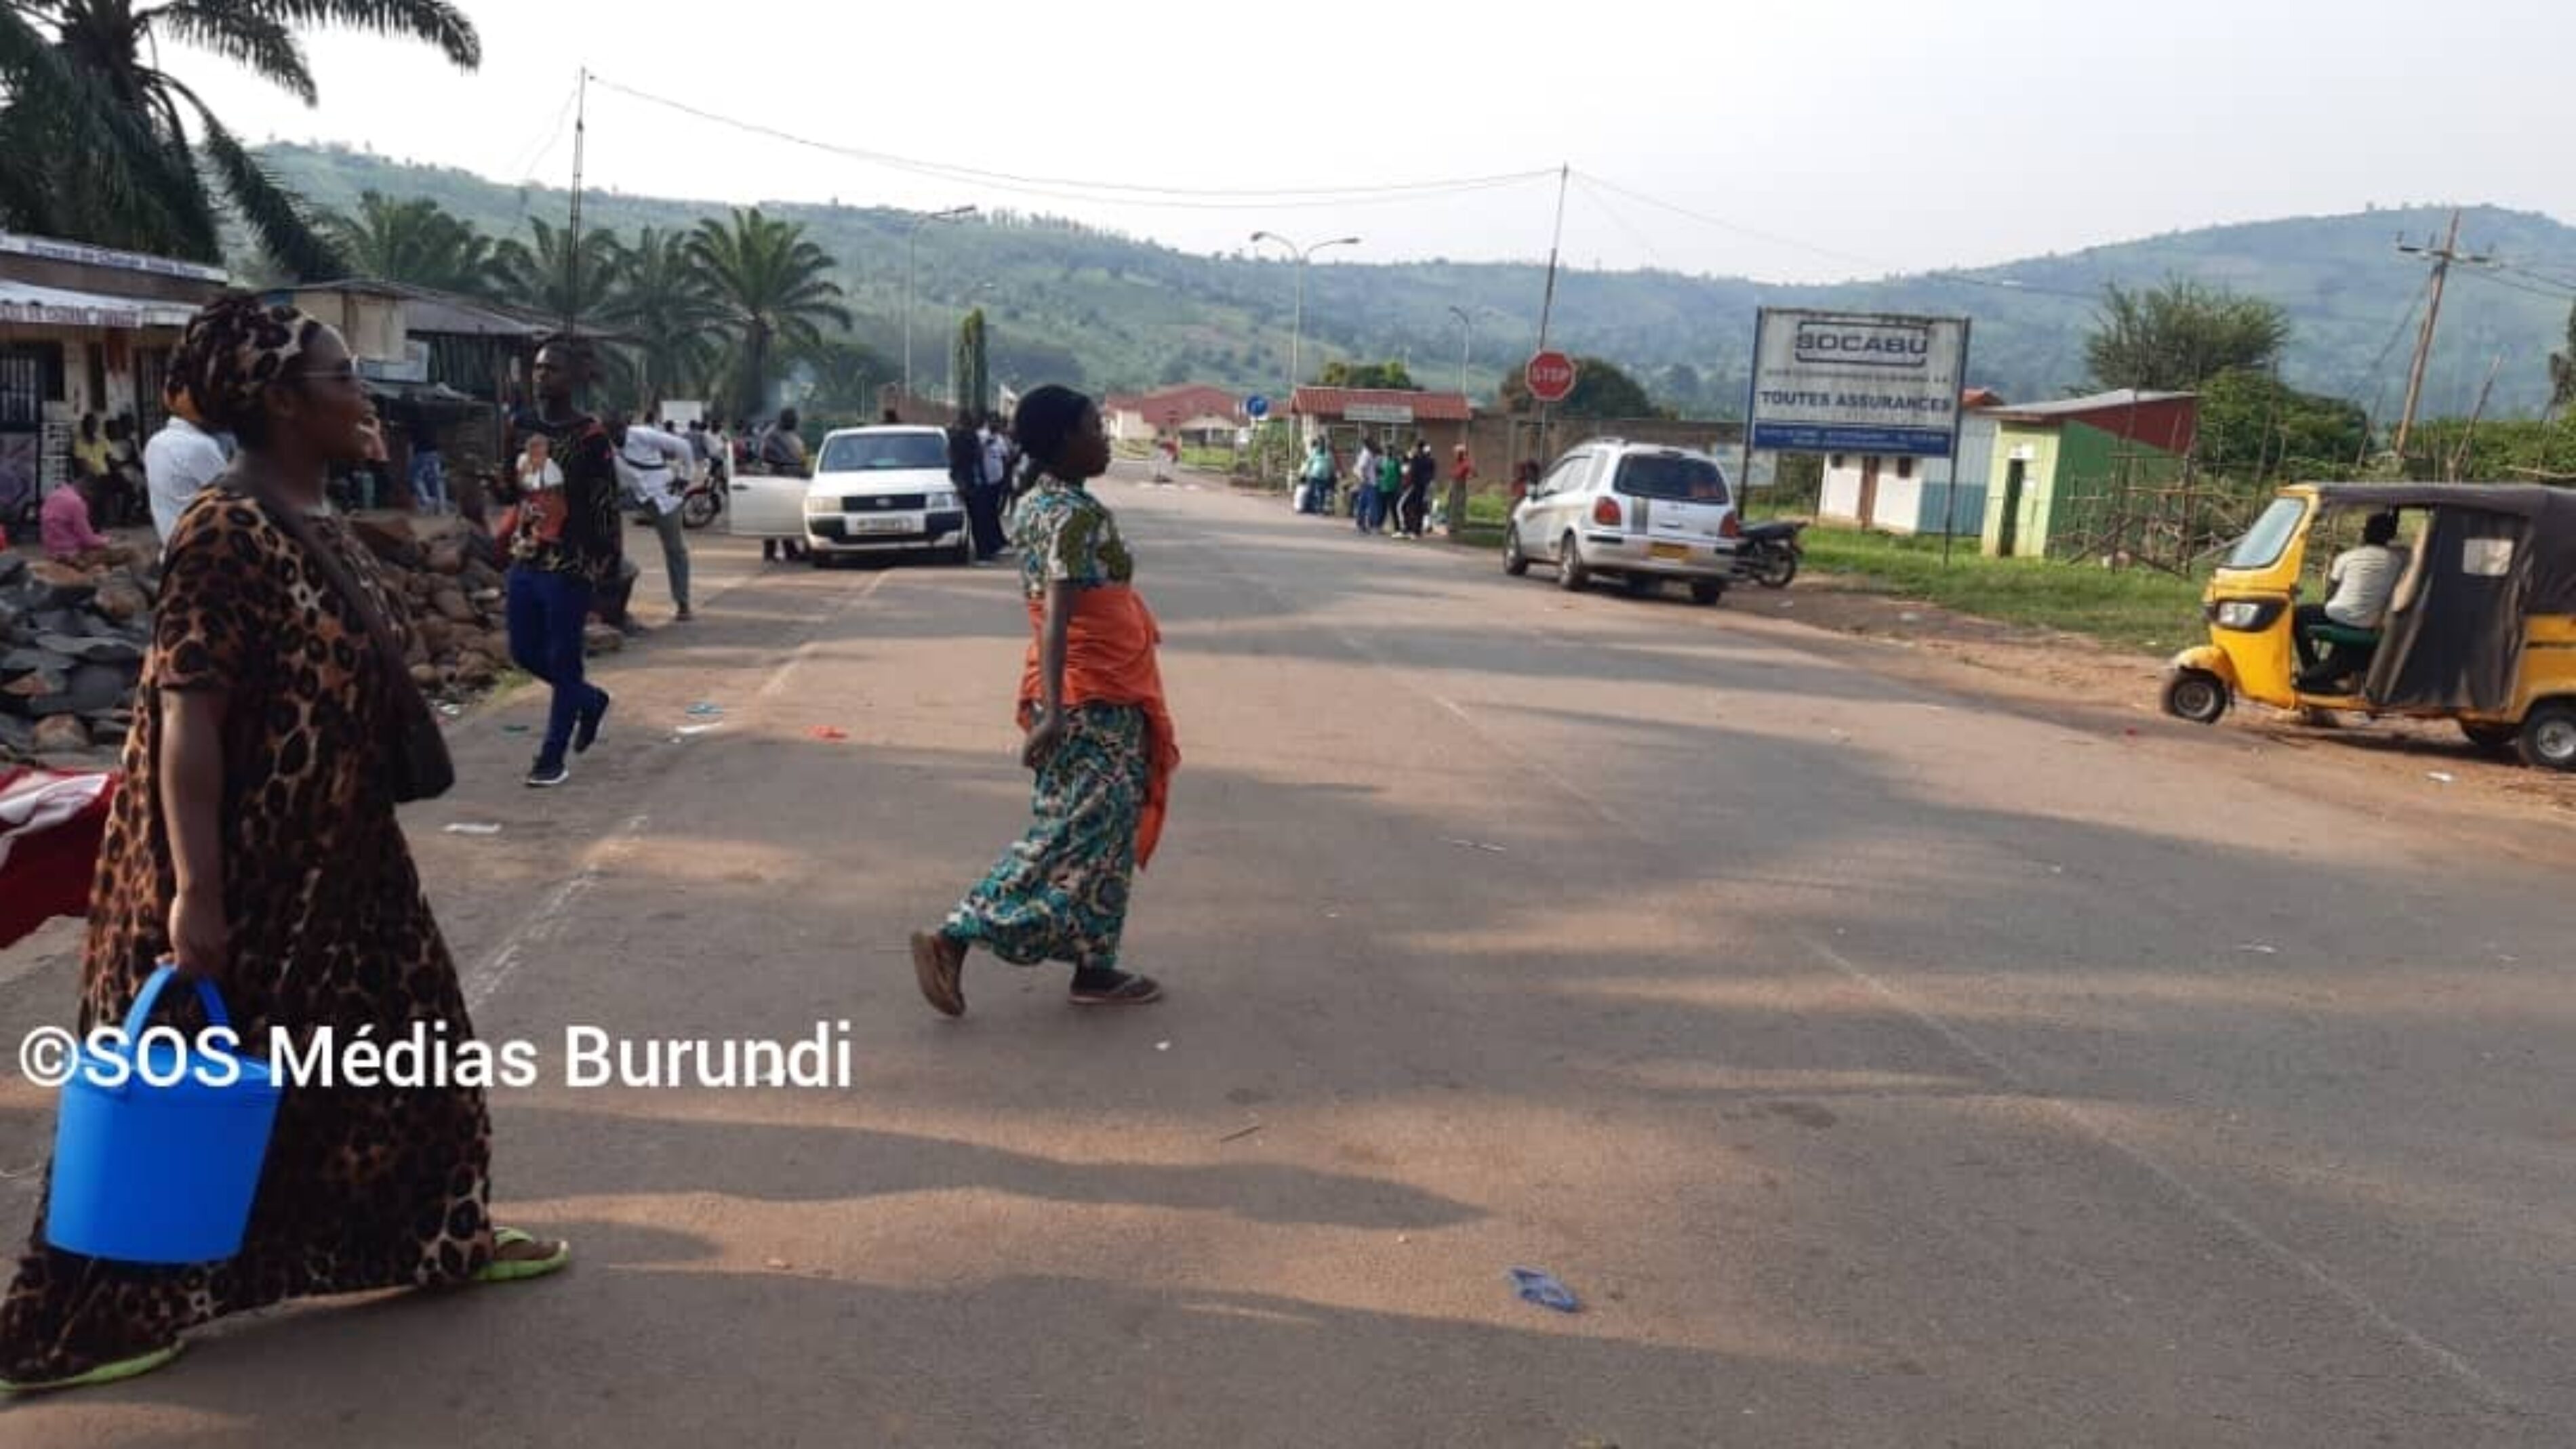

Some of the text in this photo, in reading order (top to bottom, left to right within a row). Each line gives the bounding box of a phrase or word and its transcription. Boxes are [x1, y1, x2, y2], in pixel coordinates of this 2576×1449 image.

[1796, 333, 1927, 354] SOCABU
[1532, 366, 1570, 382] STOP
[1759, 390, 1951, 411] TOUTES ASSURANCES
